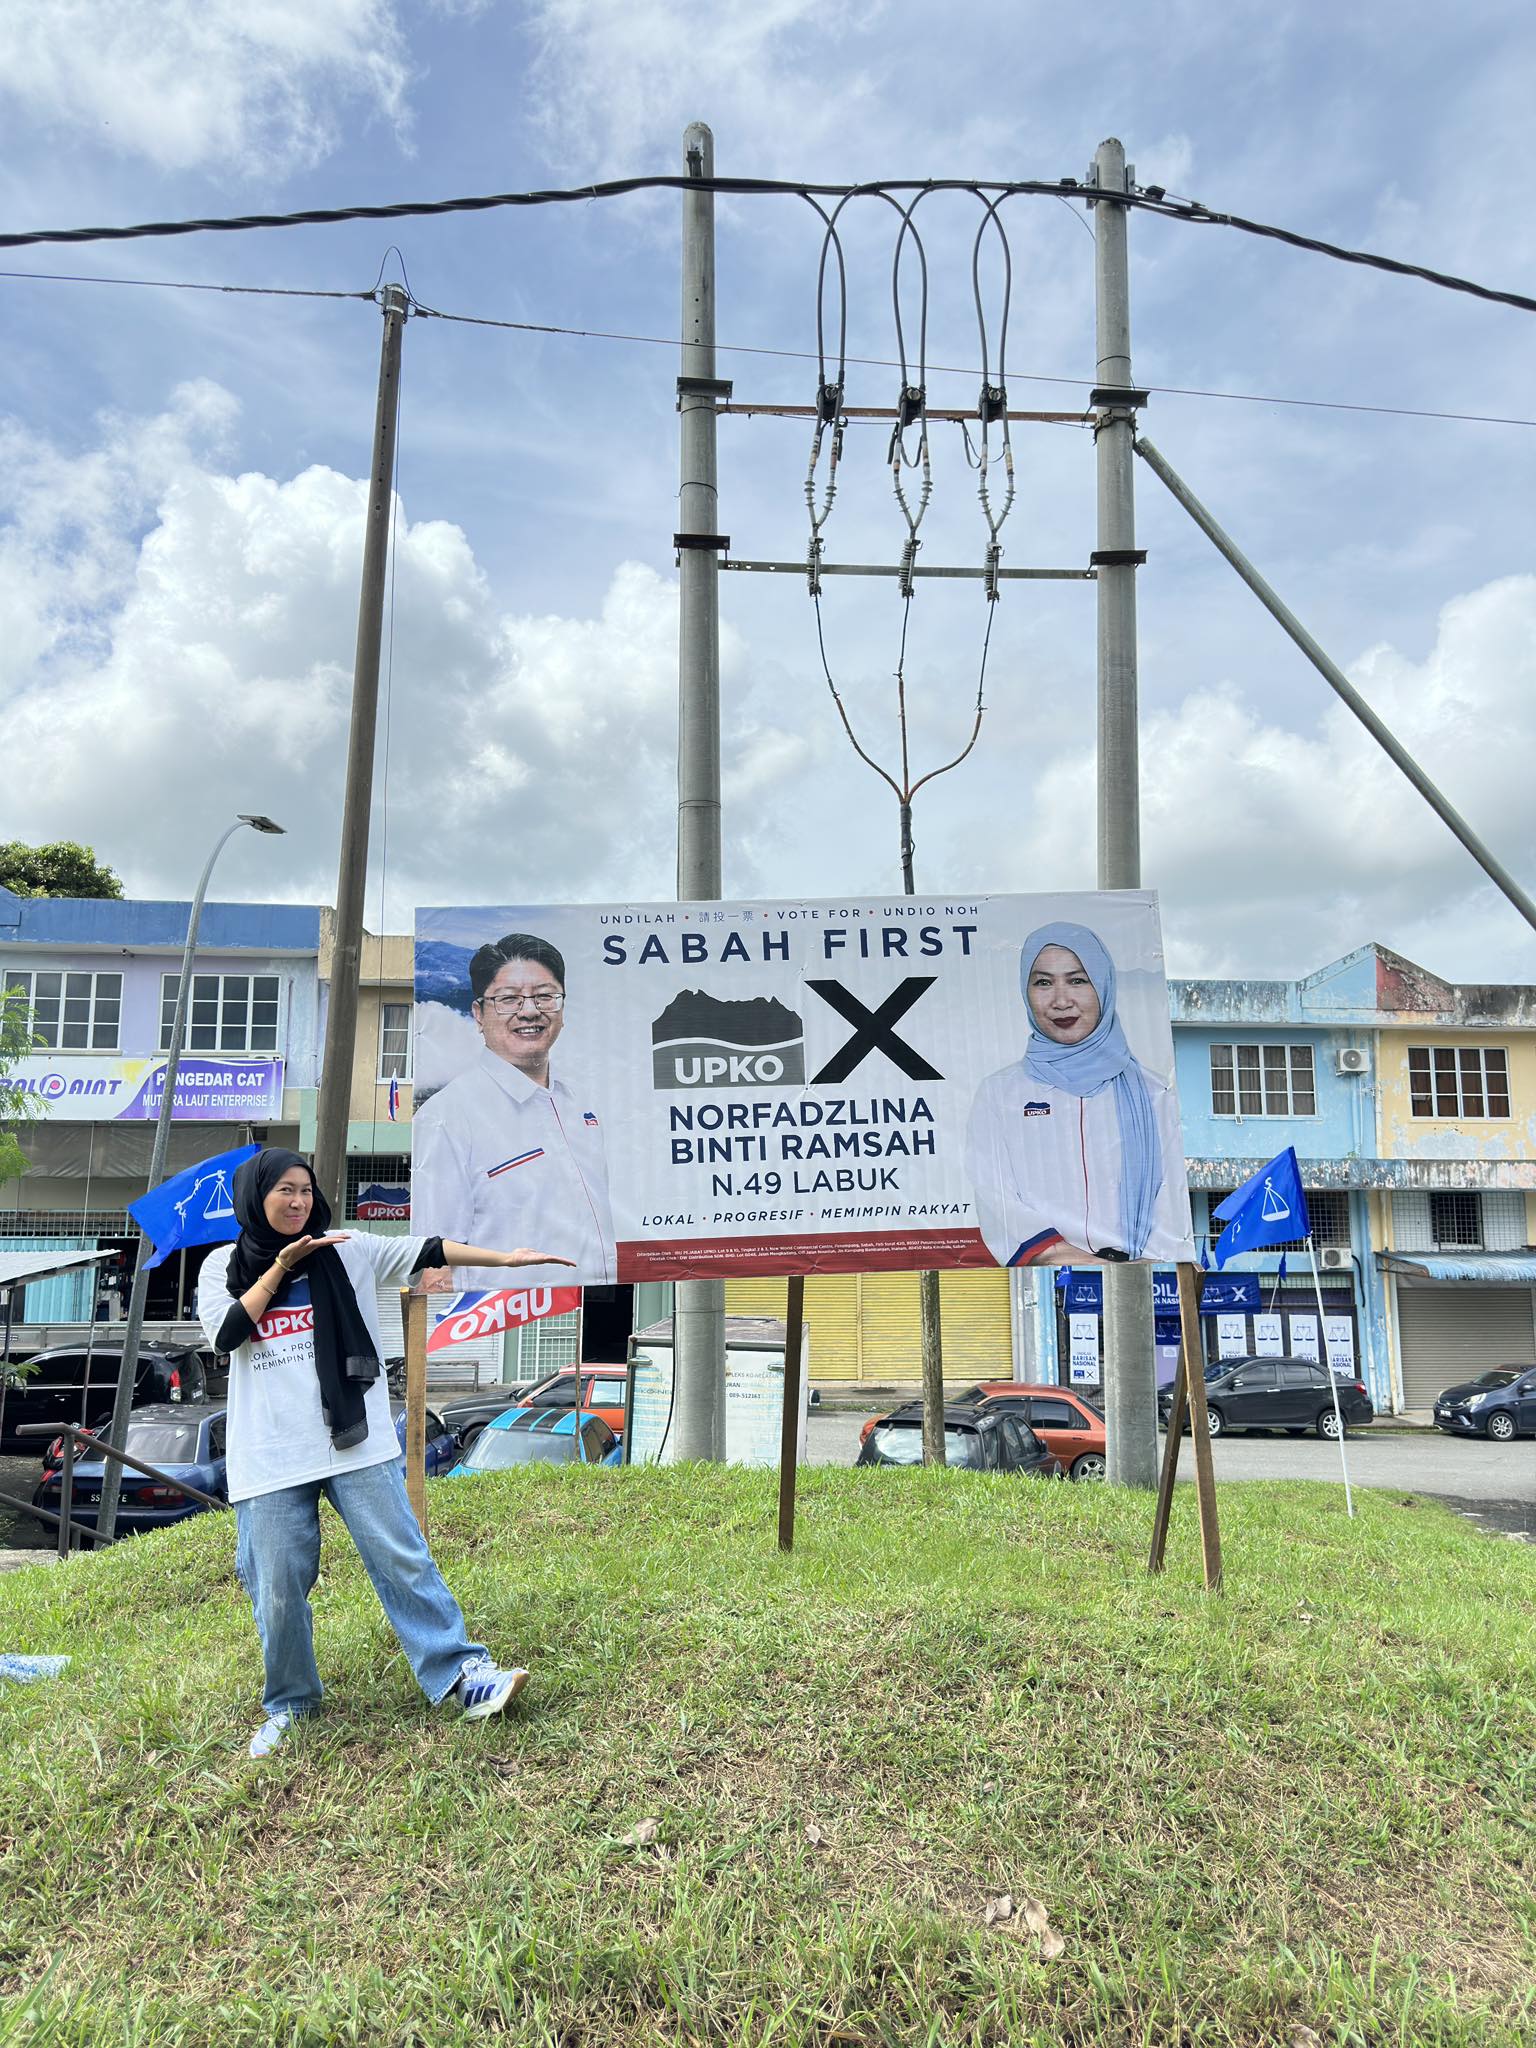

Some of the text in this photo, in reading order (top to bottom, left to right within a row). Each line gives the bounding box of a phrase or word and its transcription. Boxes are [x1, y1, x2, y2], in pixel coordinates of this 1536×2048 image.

[699, 911, 754, 923] 請投一票
[777, 908, 860, 920] VOTE FOR
[883, 906, 978, 917] UNDIO NOH
[600, 913, 675, 925] UNDILAH
[602, 925, 978, 966] SABAH FIRST
[674, 1054, 784, 1085] UPKO
[156, 1073, 265, 1087] PNGEDAR CAT
[142, 1094, 184, 1107] MUTRA
[185, 1094, 210, 1107] LAUT
[211, 1094, 267, 1107] ENTERPRISE
[670, 1097, 935, 1132] NORFADZLINA
[671, 1130, 936, 1165] BINTI RAMSAH
[712, 1168, 900, 1197] N.49 LABUK
[367, 1207, 405, 1218] UPKO
[712, 1209, 804, 1224] PROGRESIF
[820, 1203, 971, 1220] MEMIMPIN RAKYAT
[642, 1213, 695, 1227] LOKAL
